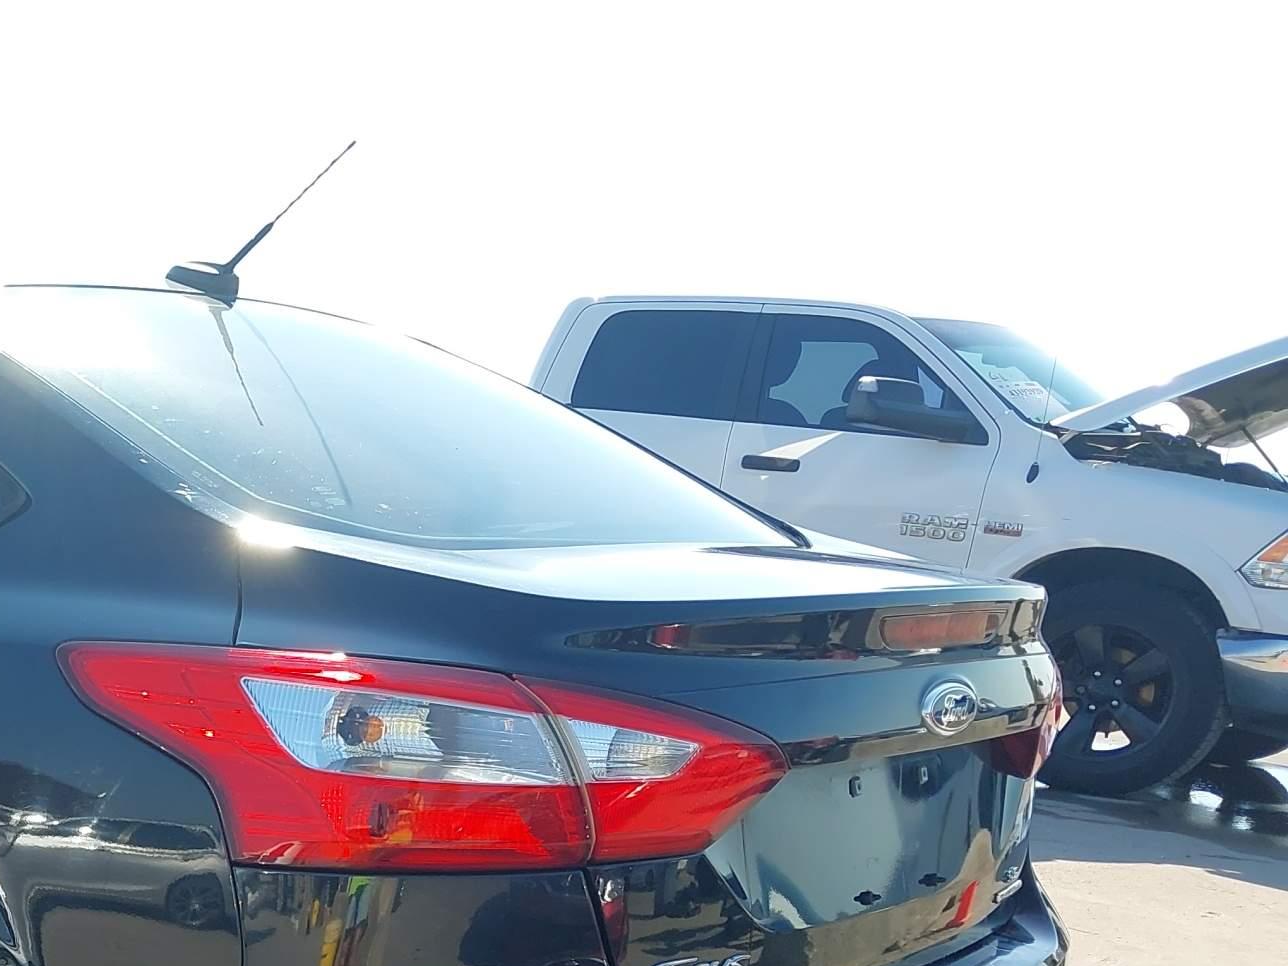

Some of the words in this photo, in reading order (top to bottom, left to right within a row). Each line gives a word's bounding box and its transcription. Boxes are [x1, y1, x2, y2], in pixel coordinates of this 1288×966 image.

[900, 512, 969, 530] RAM
[898, 523, 966, 542] 1500
[941, 694, 970, 727] Ford
